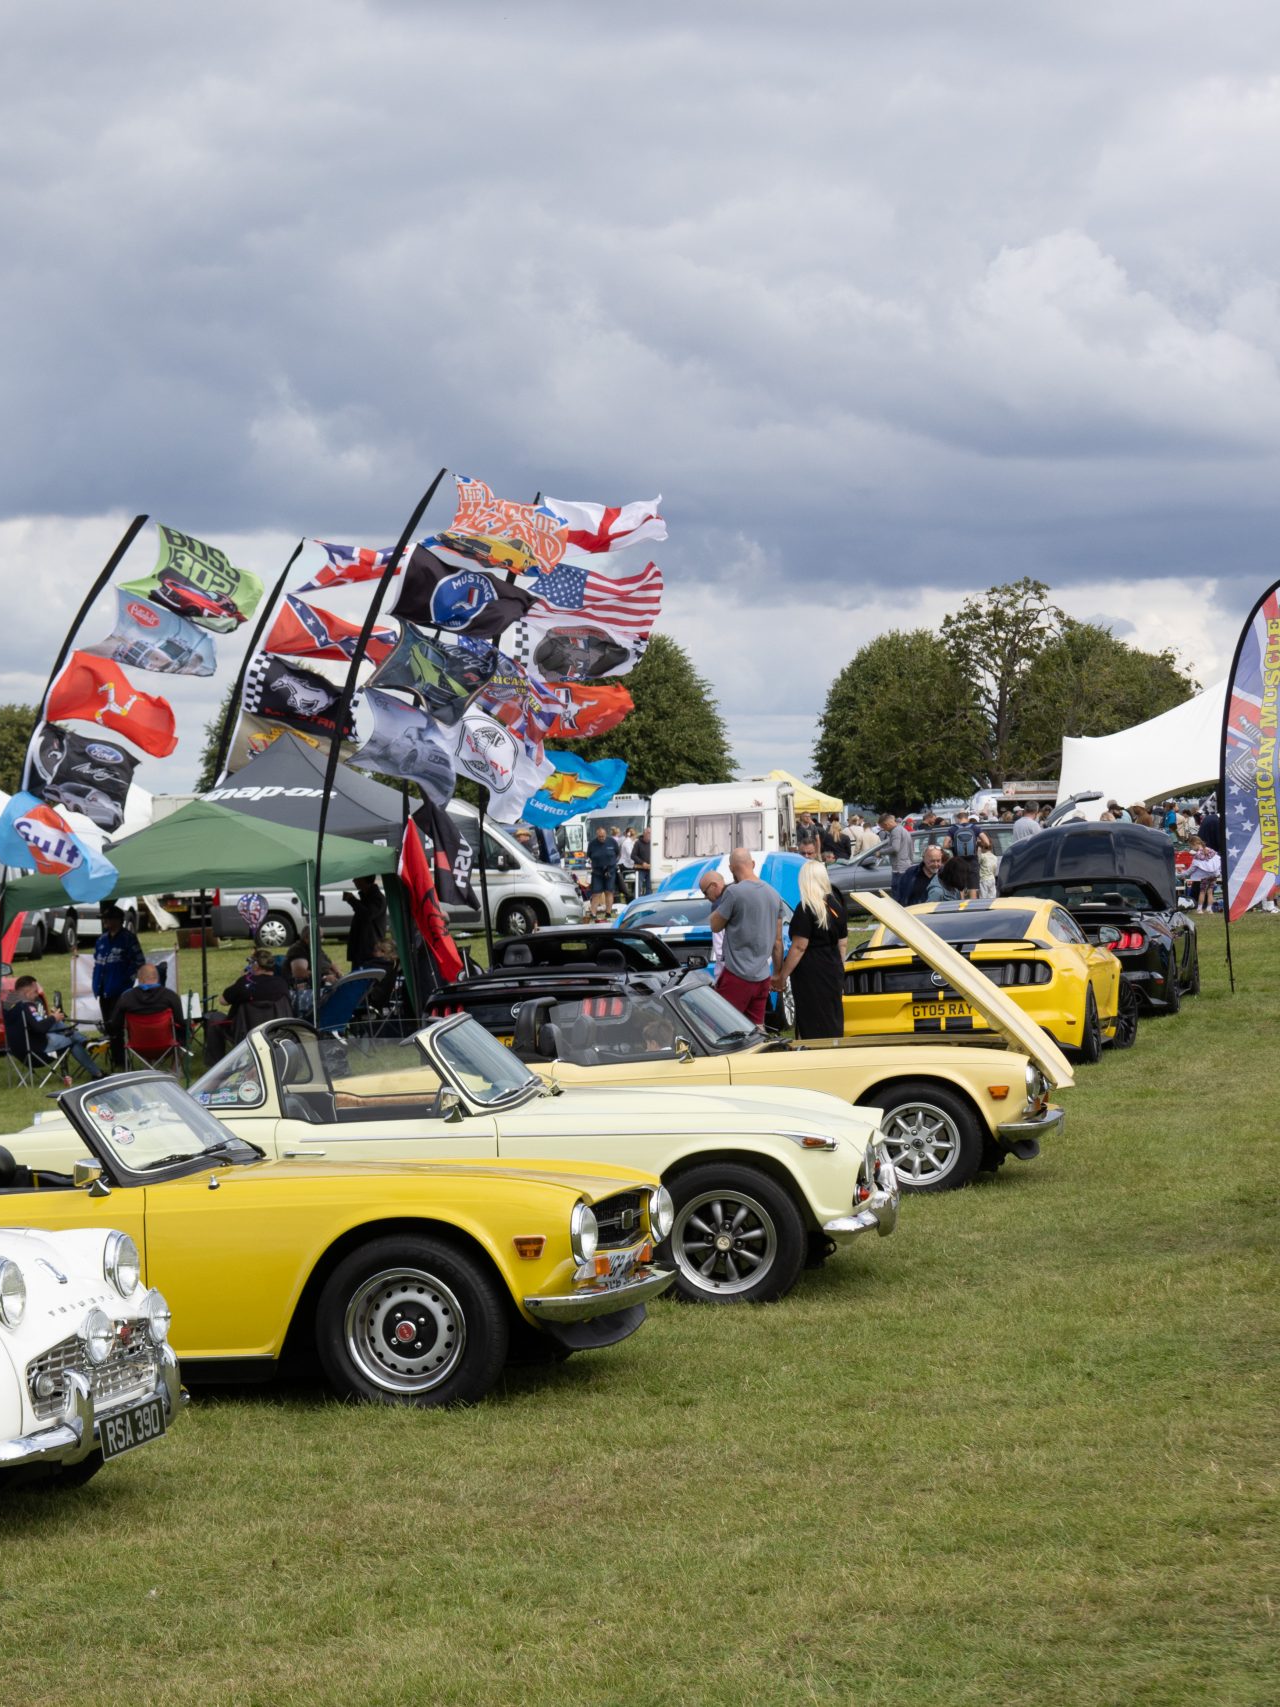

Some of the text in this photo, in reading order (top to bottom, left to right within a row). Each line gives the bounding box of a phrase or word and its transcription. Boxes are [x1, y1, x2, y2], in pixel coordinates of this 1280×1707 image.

[160, 525, 240, 583] BOSS
[169, 550, 234, 596] 302
[451, 573, 493, 601] MUSTANG
[1256, 736, 1280, 876] AMERICAN
[16, 821, 79, 864] Gulf
[912, 1003, 972, 1017] GT05 RAY
[105, 1403, 160, 1454] RSA 390
